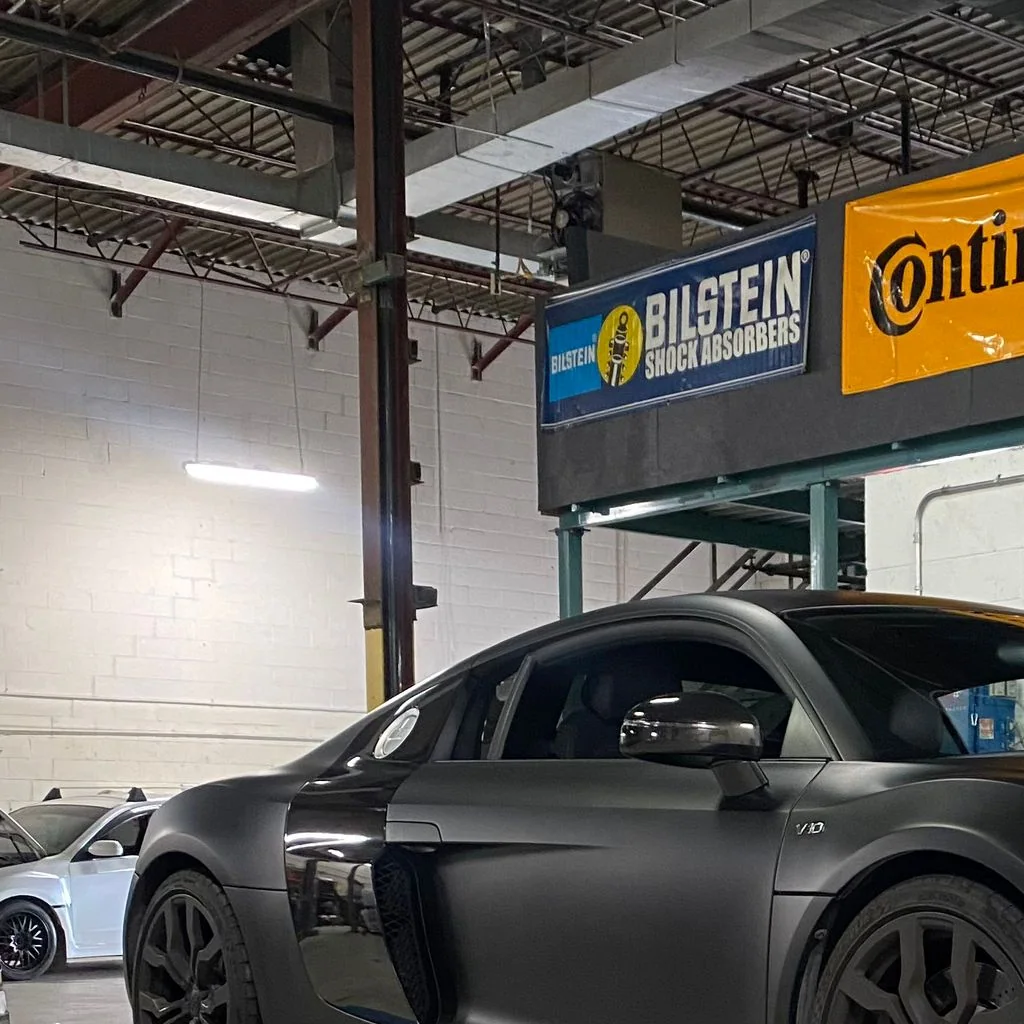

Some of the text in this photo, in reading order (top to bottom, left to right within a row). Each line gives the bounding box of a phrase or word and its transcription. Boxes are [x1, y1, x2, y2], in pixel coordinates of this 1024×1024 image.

[645, 250, 801, 350] BILSTEIN
[551, 344, 596, 375] BILSTEIN
[645, 313, 800, 380] SHOCK ABSORBERS
